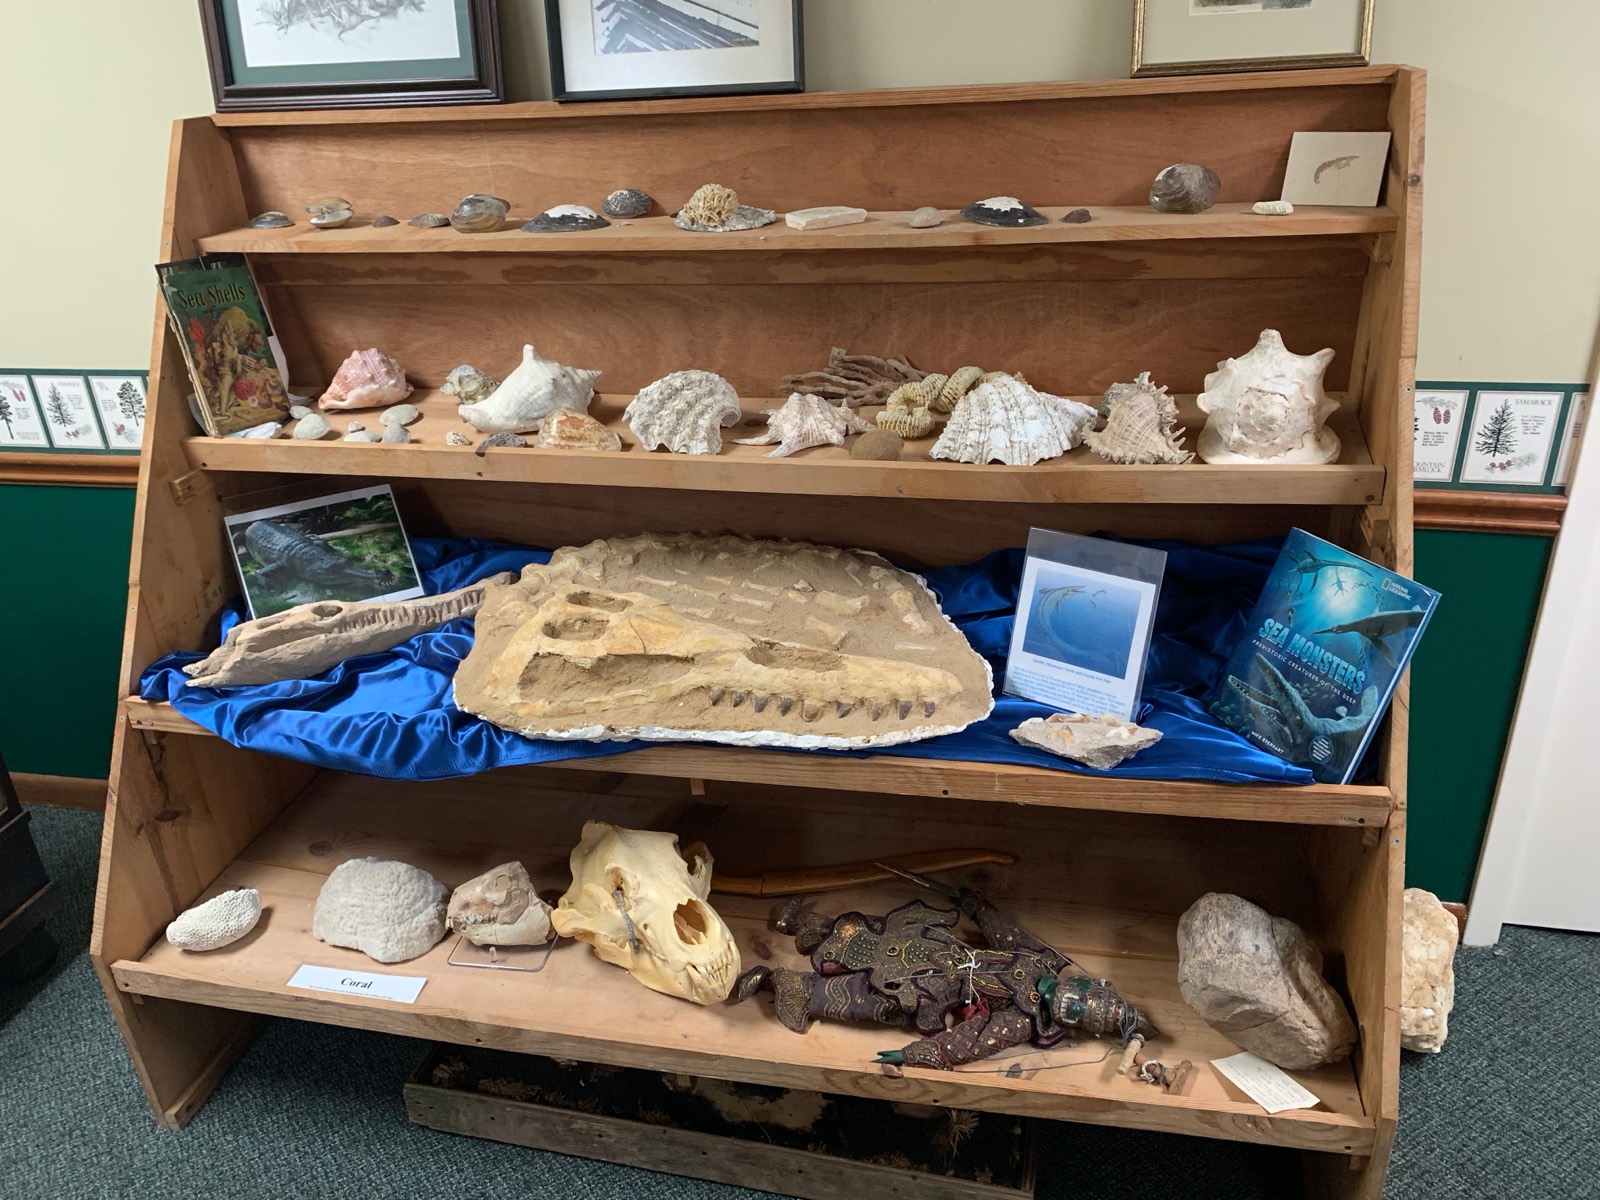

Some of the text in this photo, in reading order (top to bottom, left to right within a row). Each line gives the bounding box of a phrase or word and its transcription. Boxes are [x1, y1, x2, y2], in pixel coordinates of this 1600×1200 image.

[177, 282, 246, 309] Sea Shells
[1515, 398, 1553, 406] TAMARACK
[1414, 461, 1446, 469] OUNTAIN
[1258, 618, 1366, 695] SEA MONSTERS
[1251, 639, 1288, 662] PREHISTORIC
[1287, 660, 1319, 682] CREATURES
[1330, 686, 1341, 696] THE
[1342, 693, 1357, 705] DEEP
[1251, 730, 1284, 755] MIKE EVERHART
[340, 977, 373, 989] Coral
